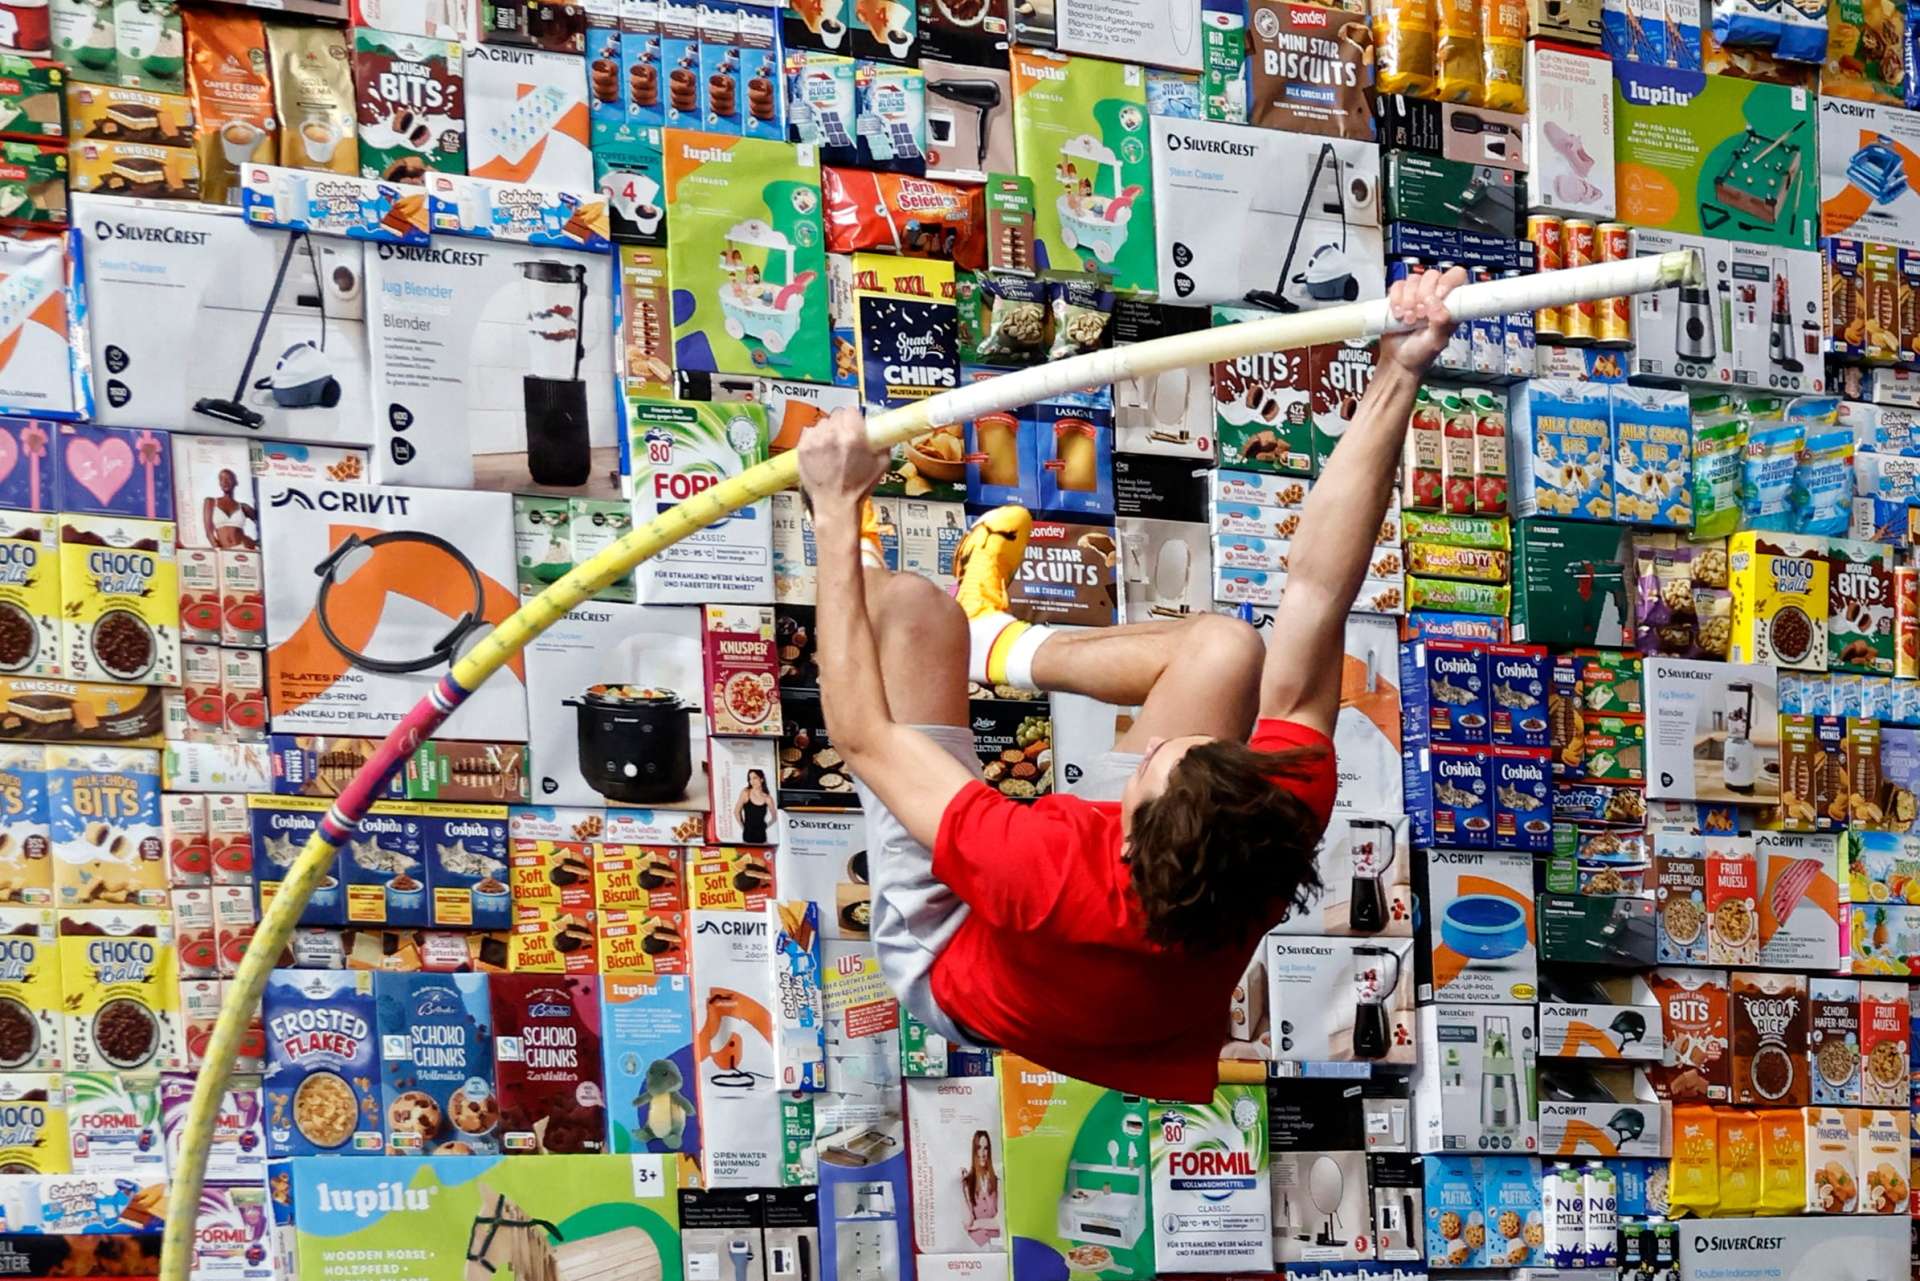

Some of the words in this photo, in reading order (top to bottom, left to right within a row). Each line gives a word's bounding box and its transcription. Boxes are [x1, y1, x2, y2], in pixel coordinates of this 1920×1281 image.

[1068, 11, 1092, 21] Board
[1291, 8, 1327, 25] Sondey
[1068, 19, 1103, 31] Planche
[1122, 36, 1135, 44] cm
[1209, 31, 1224, 45] BIO
[1279, 33, 1308, 53] MINI
[1310, 38, 1339, 59] STAR
[490, 48, 535, 65] CRIVIT
[1209, 57, 1237, 67] MILCH
[391, 61, 432, 78] NOUGAT
[1020, 63, 1066, 81] lupilu
[1264, 50, 1356, 88] BISCUITS
[109, 90, 161, 105] KINGSIZE
[380, 74, 442, 107] BITS
[1630, 80, 1688, 107] lupilu
[1840, 103, 1876, 119] CRIVIT
[115, 145, 168, 158] KINGSIZE
[1184, 135, 1256, 157] SILVERCREST
[683, 144, 733, 163] lupilu
[316, 183, 361, 199] Schoko
[622, 181, 637, 201] 4
[903, 180, 935, 195] Party
[500, 190, 544, 206] Schoko
[900, 193, 960, 210] Selection
[116, 224, 206, 246] SILVERCREST
[396, 245, 484, 267] SILVERCREST
[404, 280, 454, 299] Blender
[894, 276, 933, 297] XXL
[384, 313, 432, 332] Blender
[1507, 315, 1533, 327] MILCH
[896, 332, 935, 350] Snack
[899, 342, 927, 361] Day
[1338, 350, 1372, 362] NOUGAT
[1239, 352, 1287, 379] BITS
[883, 366, 956, 387] CHIPS
[784, 385, 820, 399] CRIVIT
[890, 388, 919, 397] MUSTARD
[1055, 406, 1094, 419] LASAGNE
[1882, 413, 1912, 425] Schoko
[650, 442, 670, 462] 80
[318, 490, 410, 515] CRIVIT
[1047, 548, 1082, 562] STAR
[1426, 554, 1454, 566] Kaubo
[90, 552, 154, 578] CHOCO
[1772, 559, 1814, 578] CHOCO
[1845, 564, 1872, 576] NOUGAT
[669, 572, 709, 580] STRAHLEND
[102, 574, 144, 594] Balls
[1838, 574, 1880, 599] BITS
[720, 640, 768, 656] KNUSPER
[1435, 657, 1477, 675] Coshida
[1496, 661, 1538, 679] Coshida
[281, 672, 331, 681] PILATES
[333, 675, 364, 683] RING
[1667, 668, 1713, 680] SILVERCREST
[11, 680, 77, 693] KINGSIZE
[282, 691, 368, 701] PILATES-RING
[284, 710, 335, 718] ANNEAU
[338, 711, 355, 719] DE
[1439, 760, 1481, 778] Coshida
[1502, 764, 1543, 781] Coshida
[74, 790, 139, 818] BITS
[271, 815, 316, 830] Coshida
[358, 818, 402, 833] Coshida
[800, 820, 851, 830] SILVERCREST
[445, 823, 489, 837] Coshida
[1772, 837, 1804, 848] CRIVIT
[1450, 854, 1485, 865] CRIVIT
[1668, 863, 1695, 874] SCHOKO
[1720, 863, 1743, 874] FRUIT
[519, 869, 544, 883] Soft
[608, 874, 631, 888] Soft
[704, 876, 728, 890] Soft
[1659, 873, 1704, 886] HAFER-MÜSLI
[1719, 875, 1748, 888] MUESLI
[514, 885, 552, 899] Biscuit
[603, 889, 640, 902] Biscuit
[700, 891, 737, 904] Biscuit
[722, 922, 767, 936] CRIVIT
[523, 936, 548, 950] Soft
[612, 939, 635, 952] Soft
[89, 941, 154, 963] CHOCO
[518, 952, 556, 966] Biscuit
[607, 954, 645, 968] Biscuit
[838, 954, 864, 976] W5
[101, 962, 146, 984] Balls
[612, 983, 658, 998] lupilu
[1558, 1007, 1589, 1017] CRIVIT
[1669, 1001, 1709, 1021] BITS
[1751, 1000, 1791, 1019] COCOA
[1822, 1006, 1849, 1017] SCHOKO
[1875, 1006, 1896, 1019] FRUIT
[270, 1009, 368, 1039] FROSTED
[1758, 1018, 1785, 1033] RICE
[1873, 1019, 1900, 1031] MUESLI
[411, 1025, 466, 1047] SCHOKO
[523, 1026, 577, 1047] SCHOKO
[284, 1033, 356, 1061] FLAKES
[413, 1047, 466, 1068] CHUNKS
[525, 1047, 578, 1068] CHUNKS
[416, 1069, 465, 1081] Vollmilch
[527, 1070, 578, 1082] Zartbitter
[1020, 1071, 1067, 1087] lupilu
[938, 1085, 972, 1095] esmara
[1558, 1106, 1587, 1116] CRIVIT
[81, 1114, 141, 1128] FORMIL
[786, 1128, 810, 1136] MILCH
[1165, 1125, 1181, 1141] 80
[713, 1159, 761, 1167] SWIMMING
[1169, 1152, 1257, 1176] FORMIL
[639, 1168, 657, 1182] 3+
[713, 1167, 738, 1175] BUOY
[51, 1181, 98, 1198] Schoko
[1181, 1180, 1246, 1189] VOLLWASCHMITTEL
[315, 1183, 431, 1213] lupilu
[1556, 1214, 1583, 1224] MILK
[1589, 1214, 1616, 1223] MILK
[1181, 1240, 1216, 1248] STRAHLEND
[1356, 1239, 1365, 1250] 3
[1711, 1236, 1783, 1252] SILVERCREST
[323, 1251, 383, 1262] WOODEN
[387, 1249, 426, 1260] HORSE
[324, 1264, 400, 1276] HOLZPFERD
[948, 1261, 982, 1270] esmara
